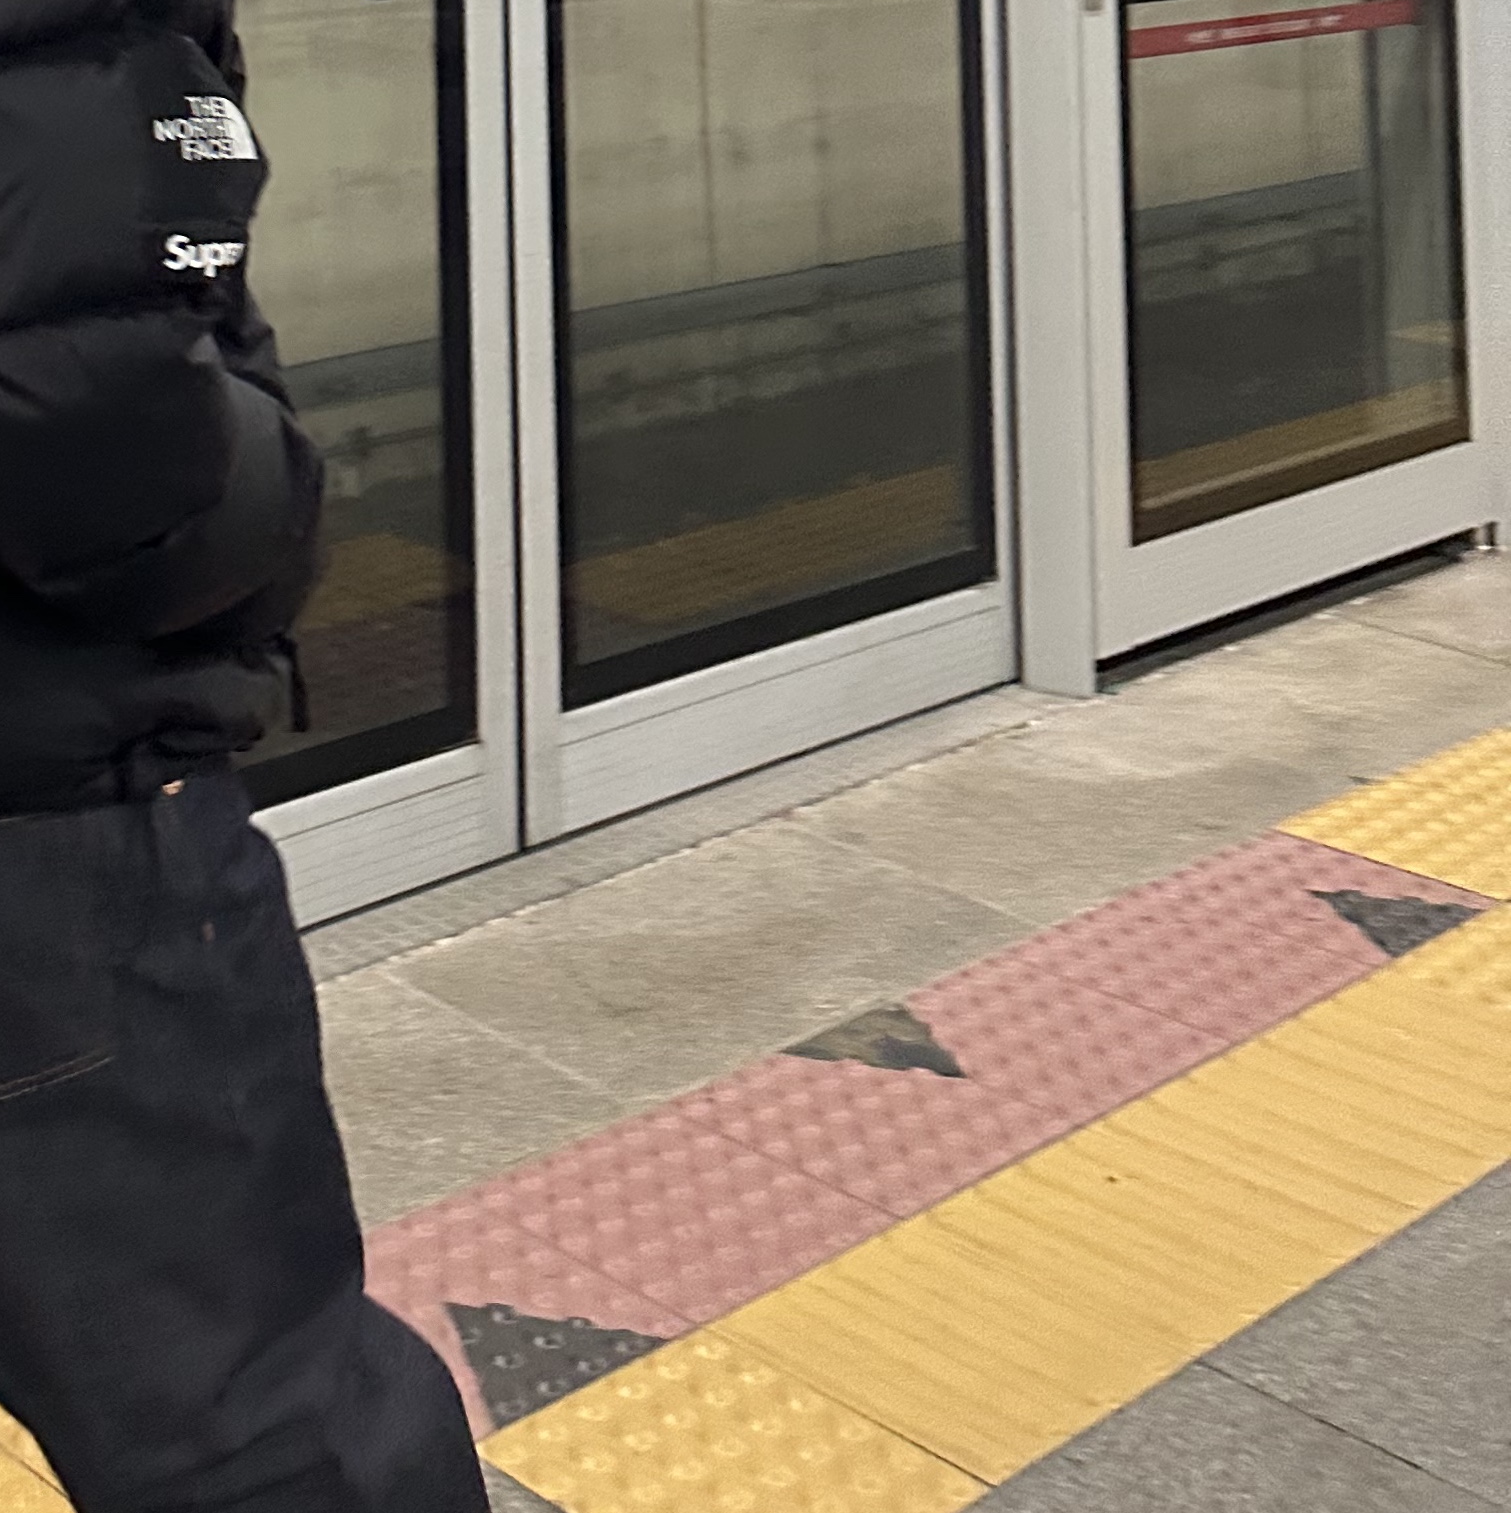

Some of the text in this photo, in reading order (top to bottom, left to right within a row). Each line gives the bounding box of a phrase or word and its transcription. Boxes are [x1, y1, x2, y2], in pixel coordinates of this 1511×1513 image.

[184, 95, 226, 117] THE
[152, 117, 230, 142] NORTH
[180, 138, 233, 161] FACE
